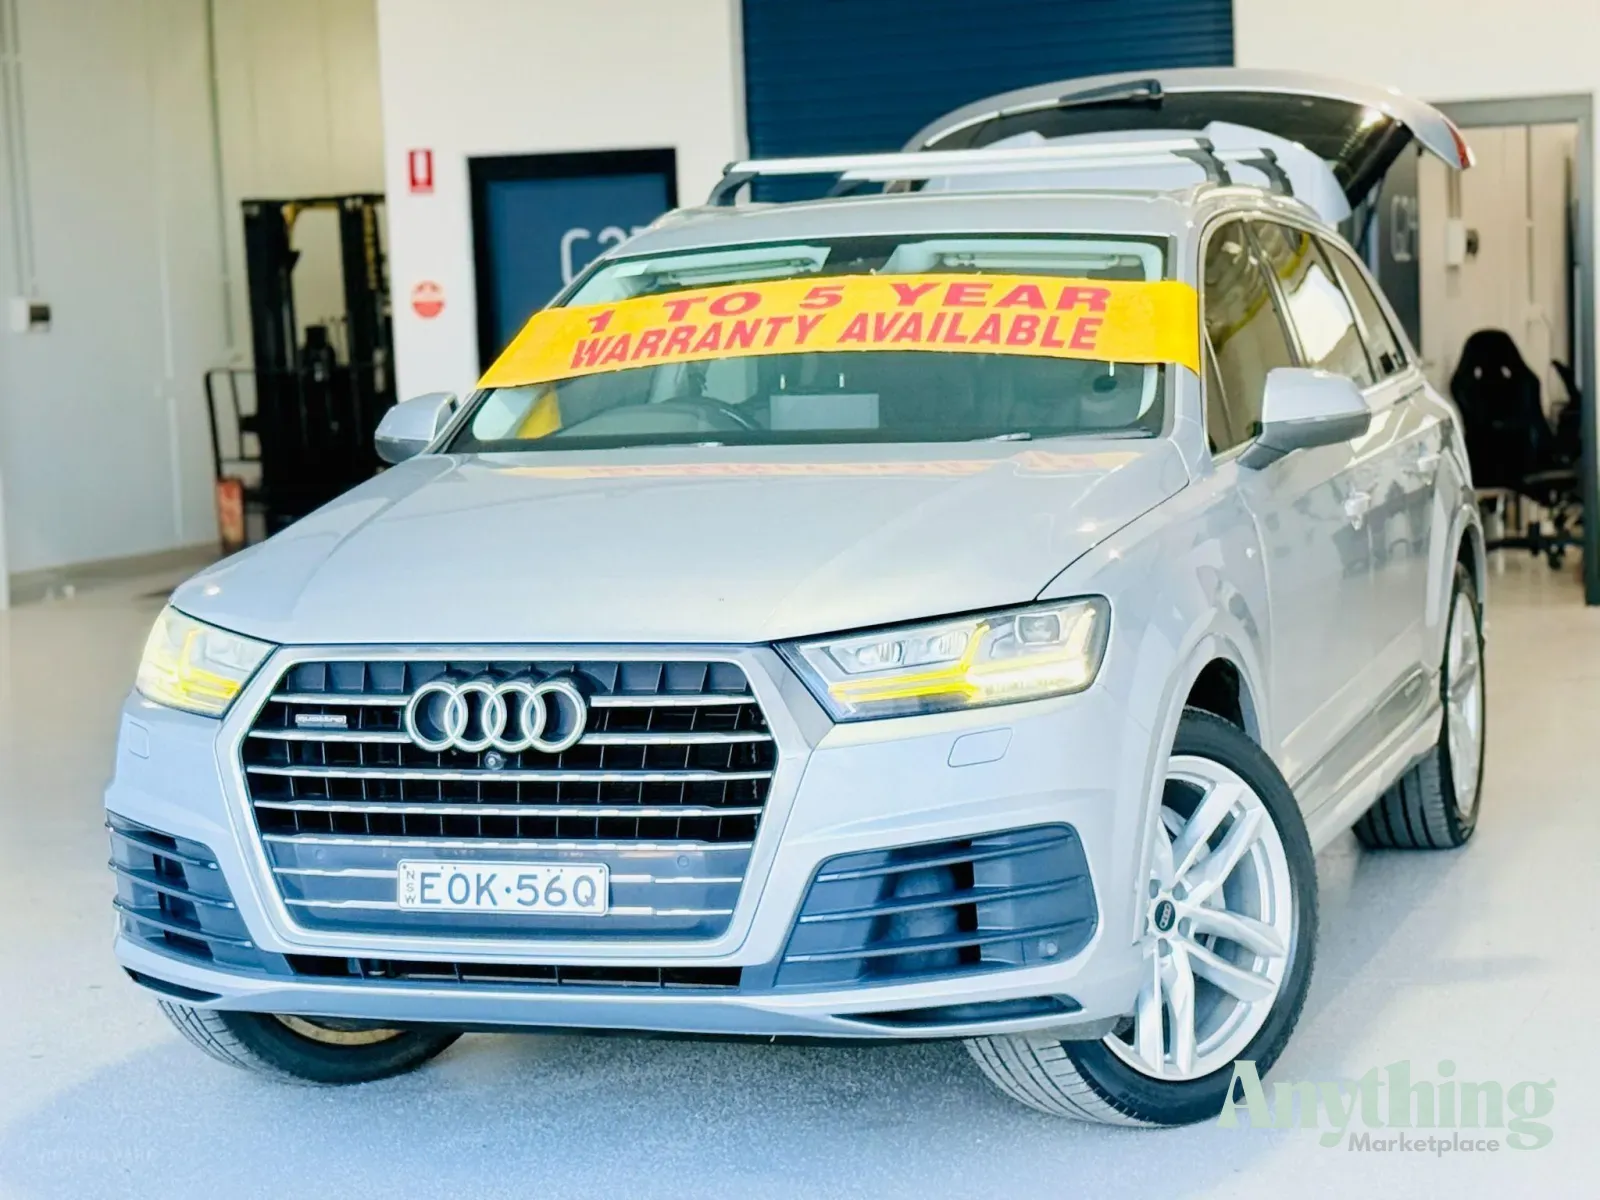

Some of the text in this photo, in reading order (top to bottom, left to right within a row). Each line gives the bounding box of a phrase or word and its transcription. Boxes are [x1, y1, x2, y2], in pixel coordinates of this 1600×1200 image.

[588, 283, 1112, 334] 1 TO 5 YEAR
[570, 312, 1103, 369] WARRANTY AVAILABLE
